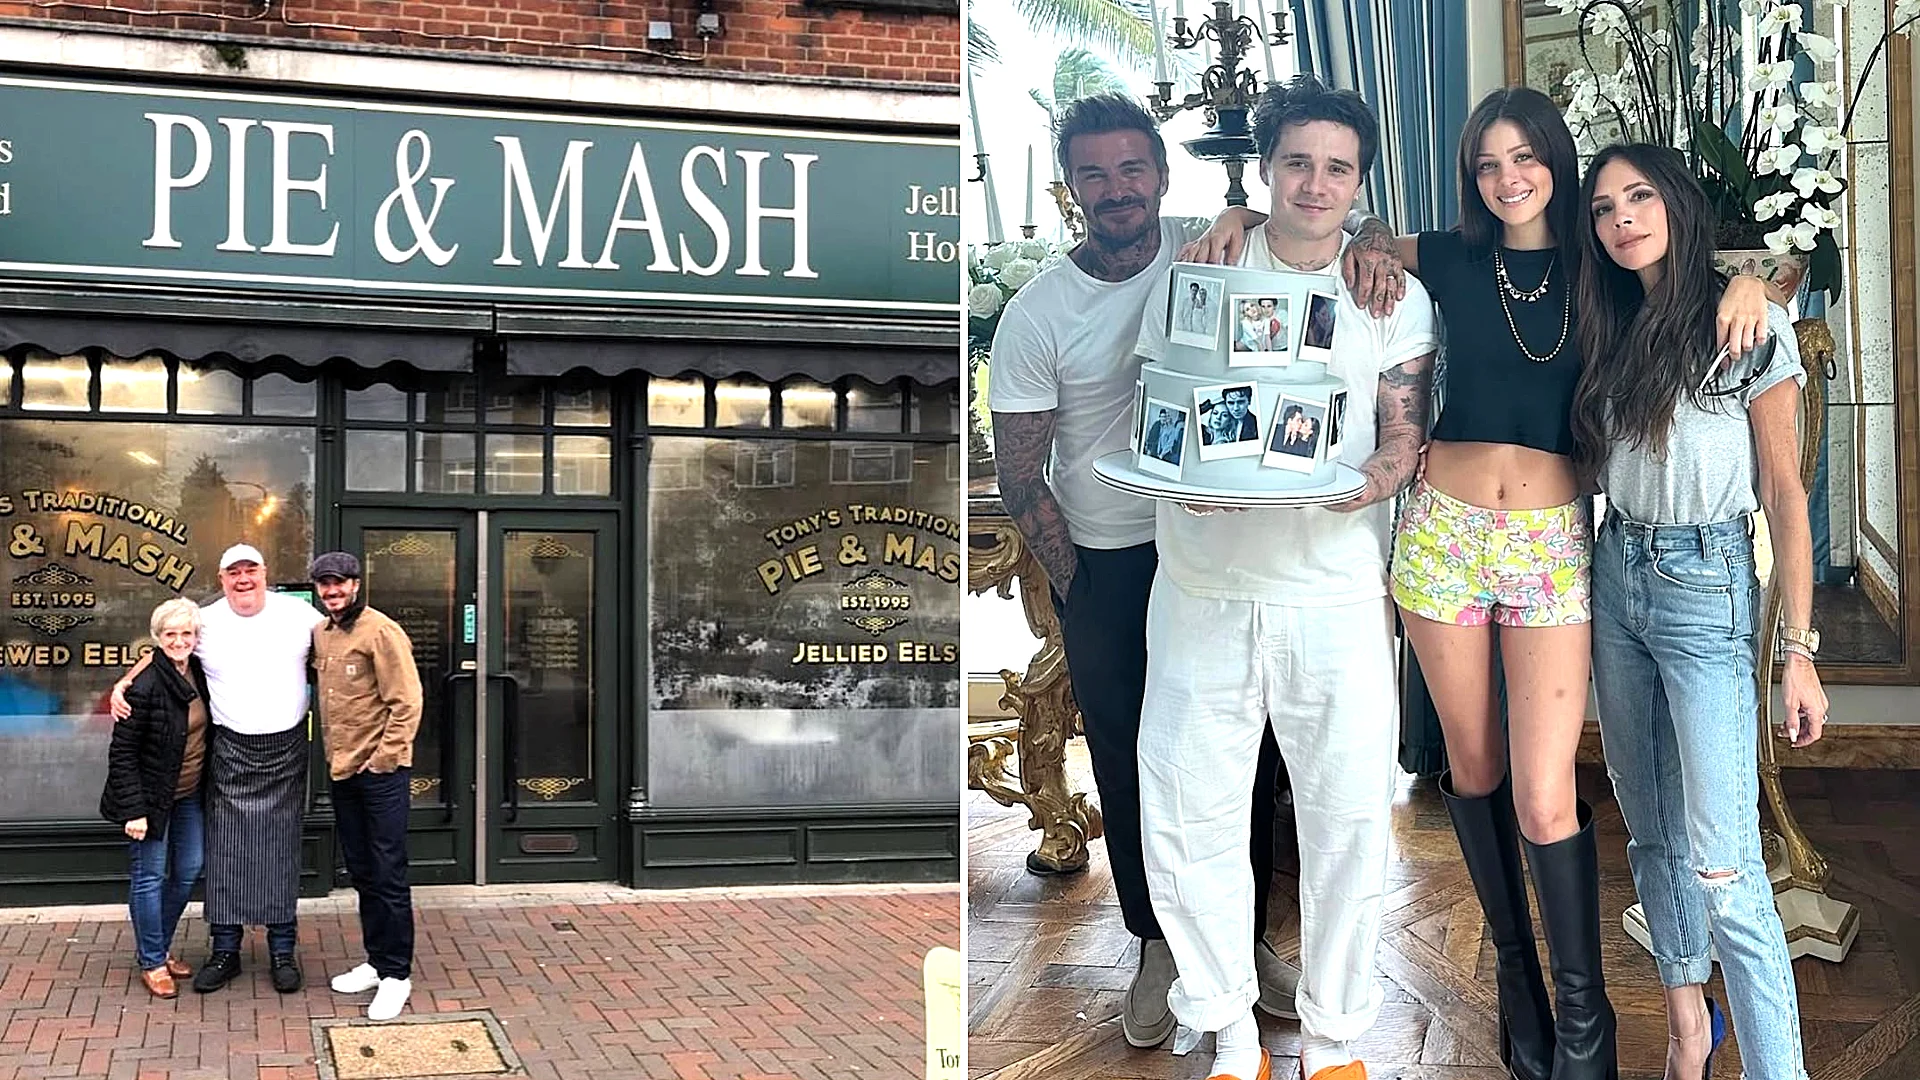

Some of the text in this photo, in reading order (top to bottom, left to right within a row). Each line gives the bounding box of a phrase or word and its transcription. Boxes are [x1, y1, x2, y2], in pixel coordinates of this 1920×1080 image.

[142, 112, 819, 279] PIE & MASH
[23, 490, 187, 543] TRADITIONAL
[765, 509, 842, 548] TONY'S
[9, 520, 193, 589] & MASH
[757, 531, 960, 593] PIE & MAS
[11, 592, 95, 607] EST. 1995
[841, 596, 910, 609] EST. 1995
[0, 645, 71, 666] WED
[791, 641, 957, 664] JELLIED EELS
